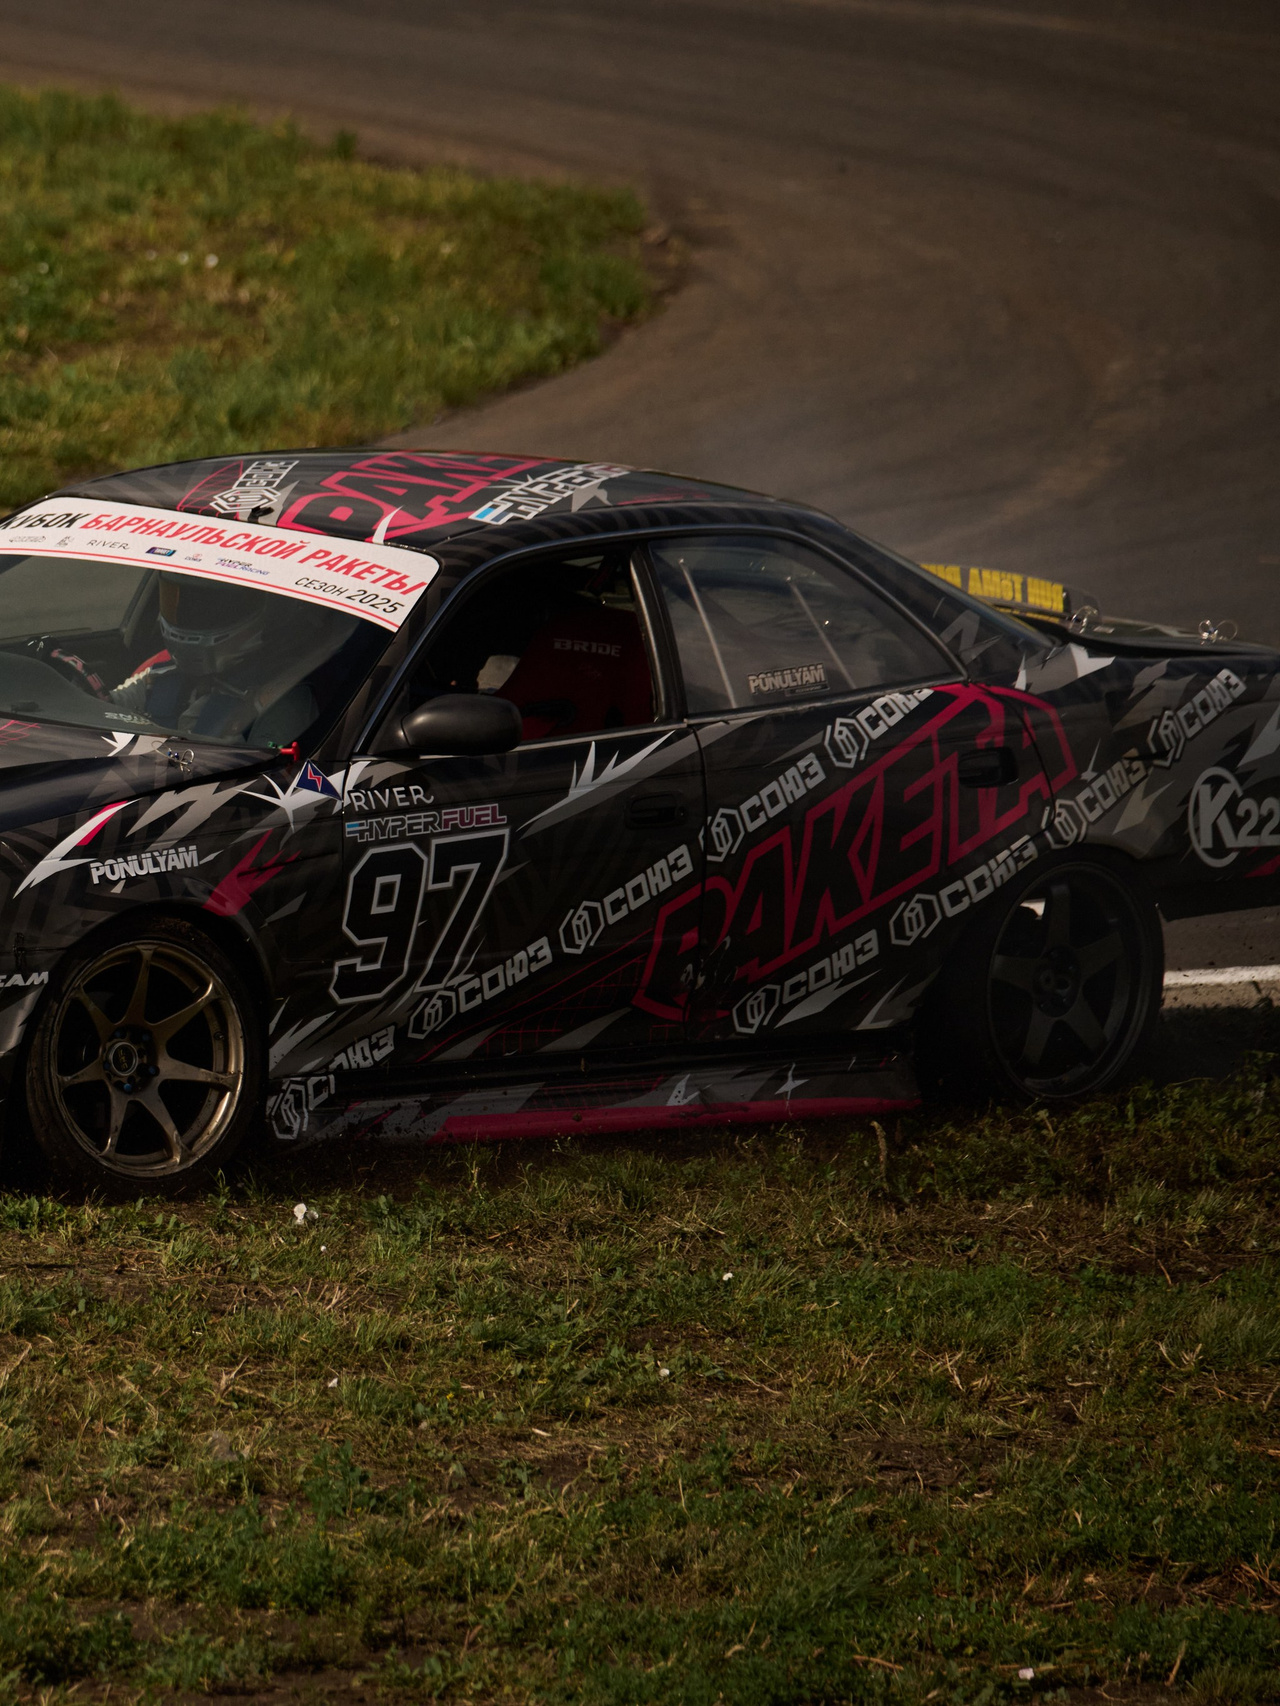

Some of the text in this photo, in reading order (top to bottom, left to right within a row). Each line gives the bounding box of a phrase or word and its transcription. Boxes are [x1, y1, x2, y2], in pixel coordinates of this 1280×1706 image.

[80, 514, 312, 560] БАРНАУЛЬСКОЙ
[298, 549, 427, 596] РАКЕТЫ
[87, 540, 131, 550] RIVER
[295, 577, 406, 614] СЕЗОН 2025
[553, 638, 622, 659] BRIDE
[747, 663, 826, 694] PONULYAM
[349, 785, 434, 812] RIVER
[90, 845, 199, 885] PONULYAM
[328, 827, 510, 1005] 97
